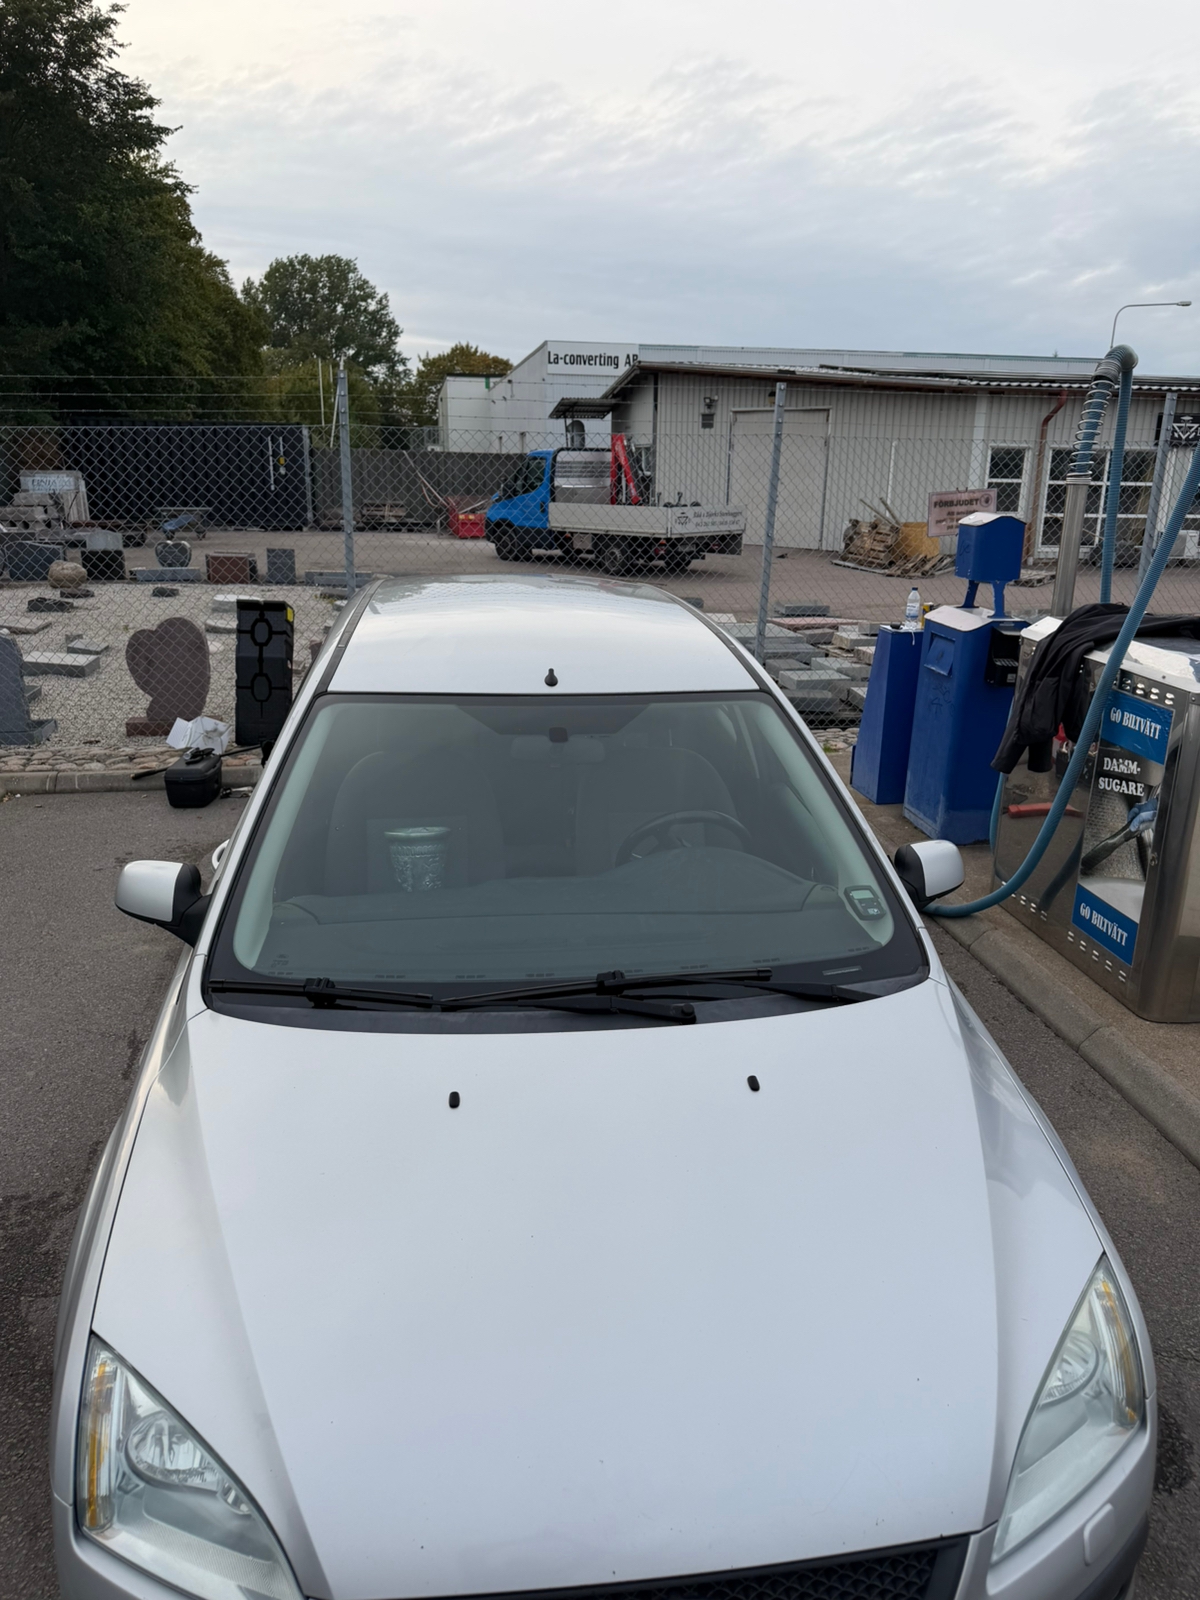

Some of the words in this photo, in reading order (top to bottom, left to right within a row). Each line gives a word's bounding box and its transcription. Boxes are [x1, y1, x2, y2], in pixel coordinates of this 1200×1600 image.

[547, 350, 619, 369] La-converting
[934, 498, 979, 508] FÖRBJUDET
[1110, 707, 1122, 724] GO
[1122, 711, 1161, 739] BILTVÄTT
[1103, 757, 1141, 775] DAMM-
[1098, 777, 1145, 797] SUGARE
[1080, 902, 1091, 920] GO
[1091, 910, 1128, 947] BILTVÄTT
